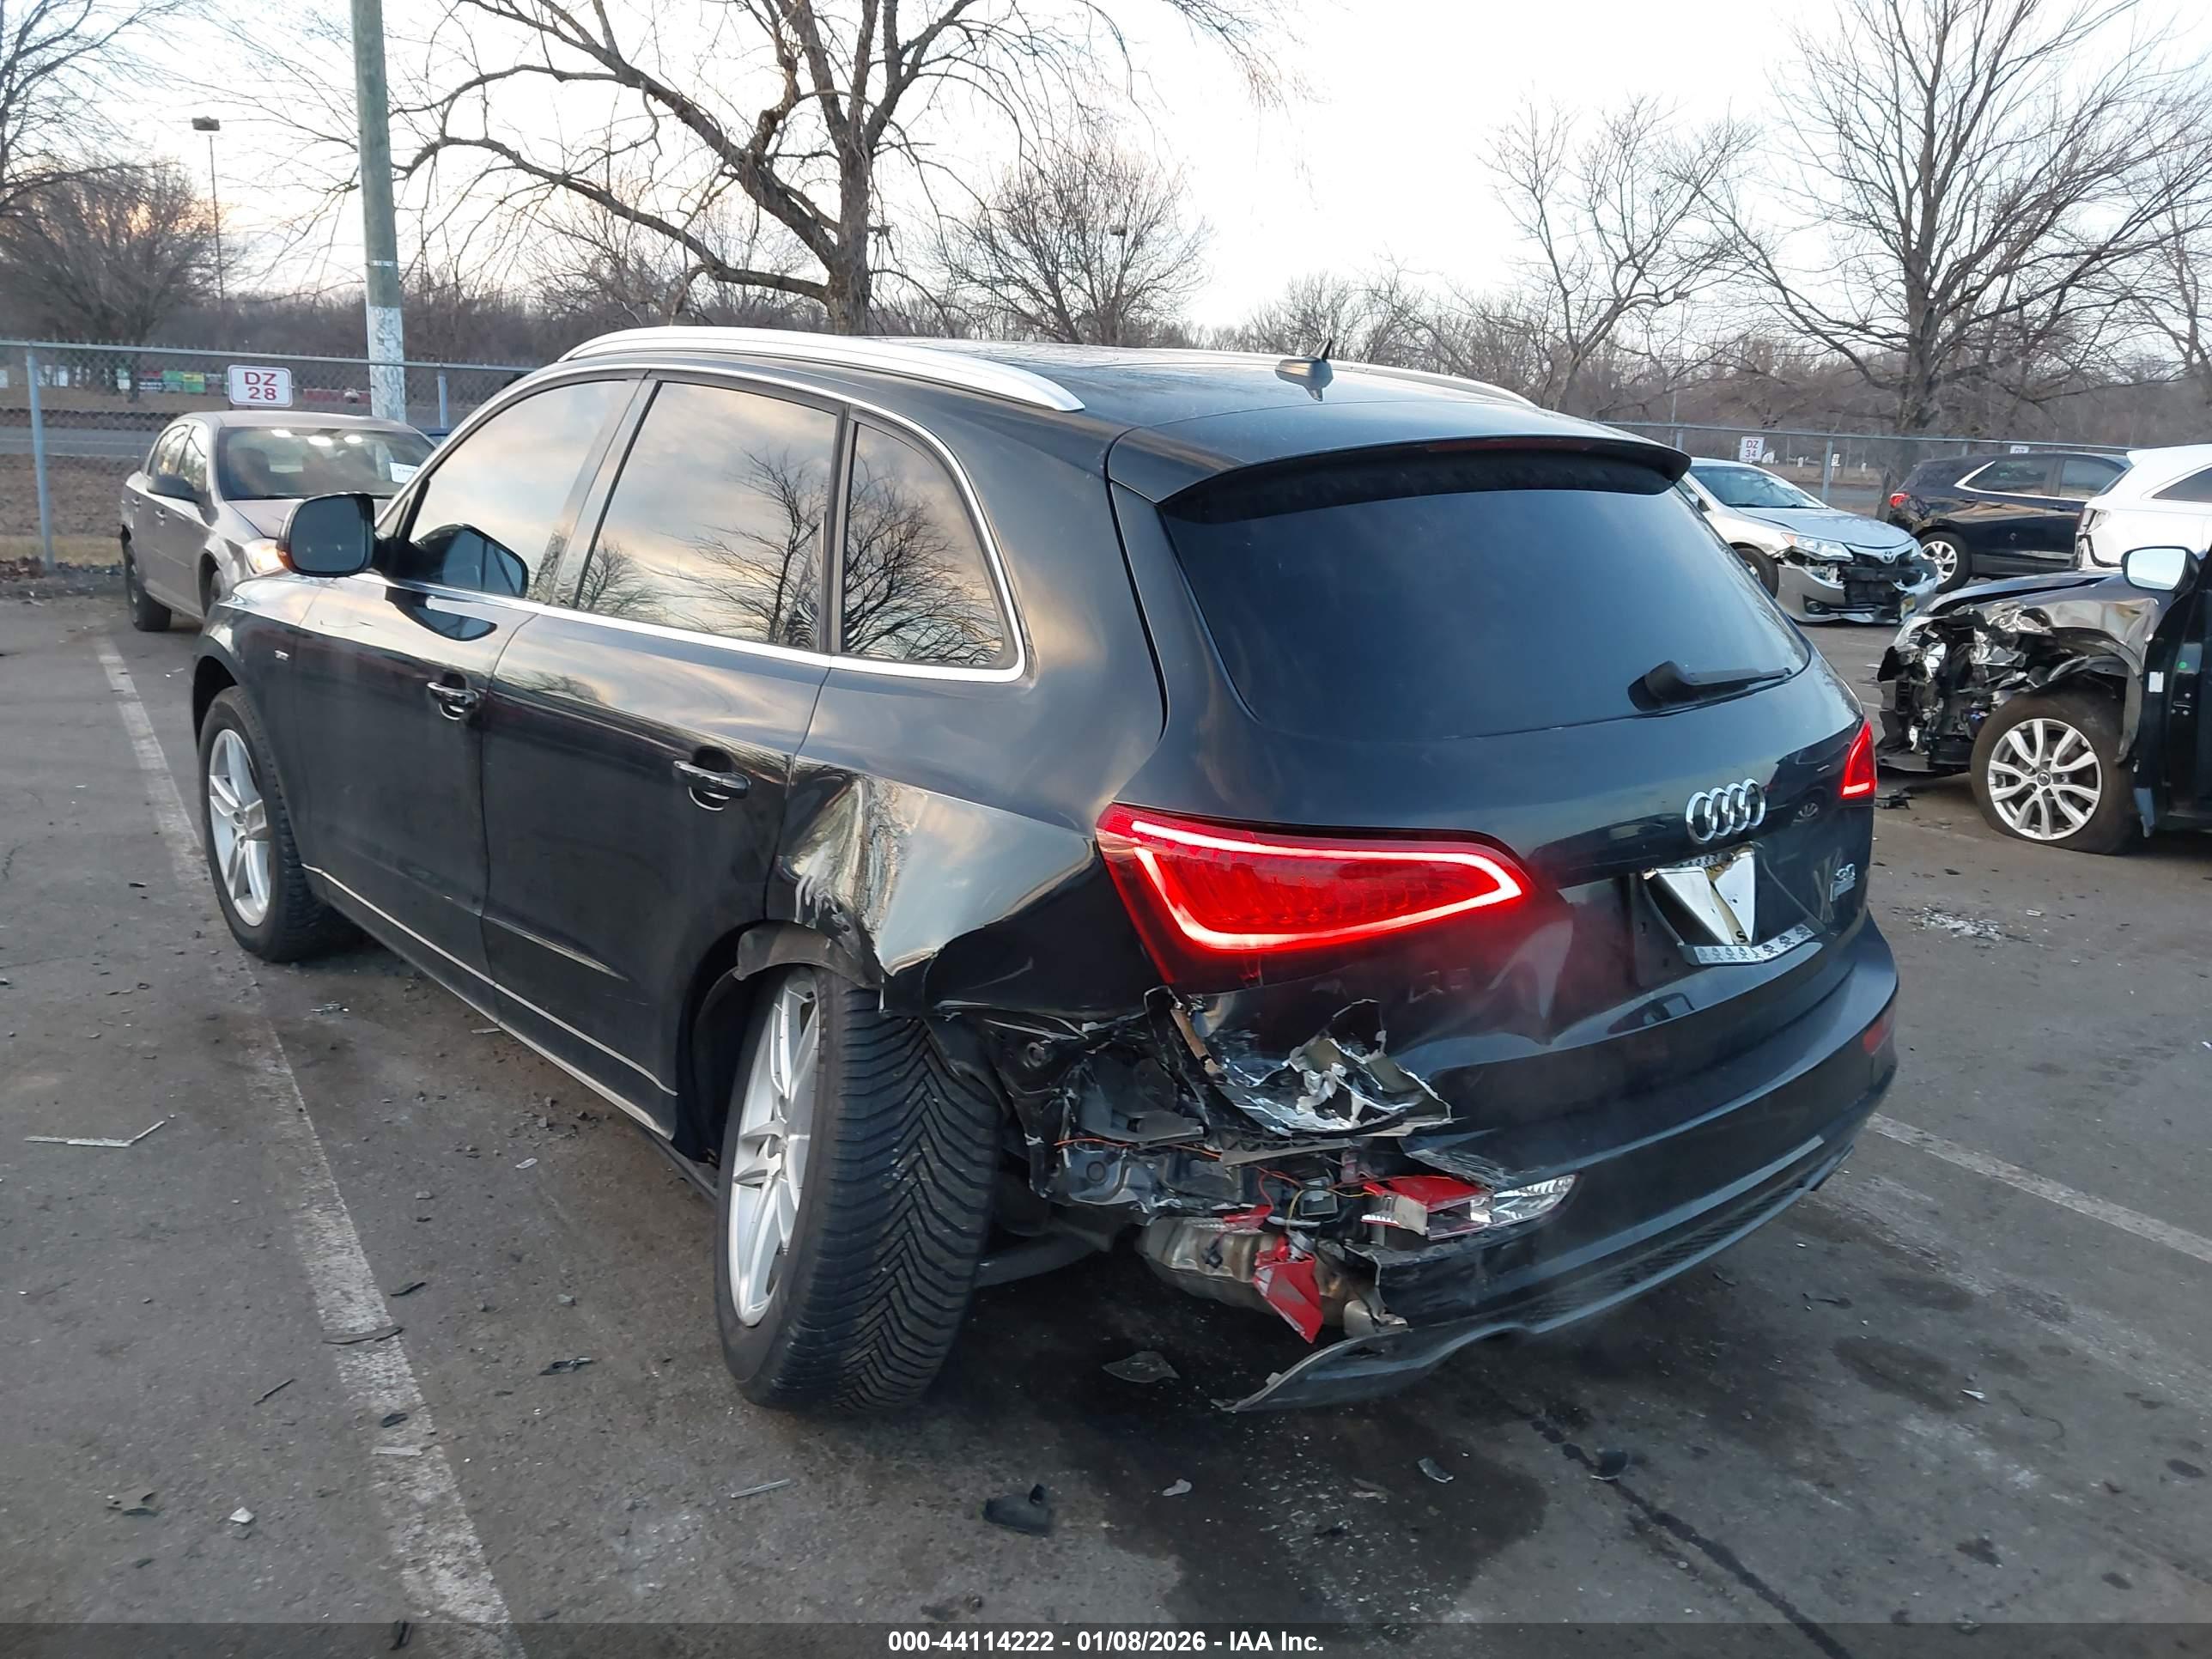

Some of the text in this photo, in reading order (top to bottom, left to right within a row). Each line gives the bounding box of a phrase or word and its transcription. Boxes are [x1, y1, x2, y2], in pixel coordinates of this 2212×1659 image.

[244, 372, 277, 386] DZ
[247, 386, 277, 401] 28
[1746, 440, 1759, 449] DZ
[1745, 449, 1757, 458] 34
